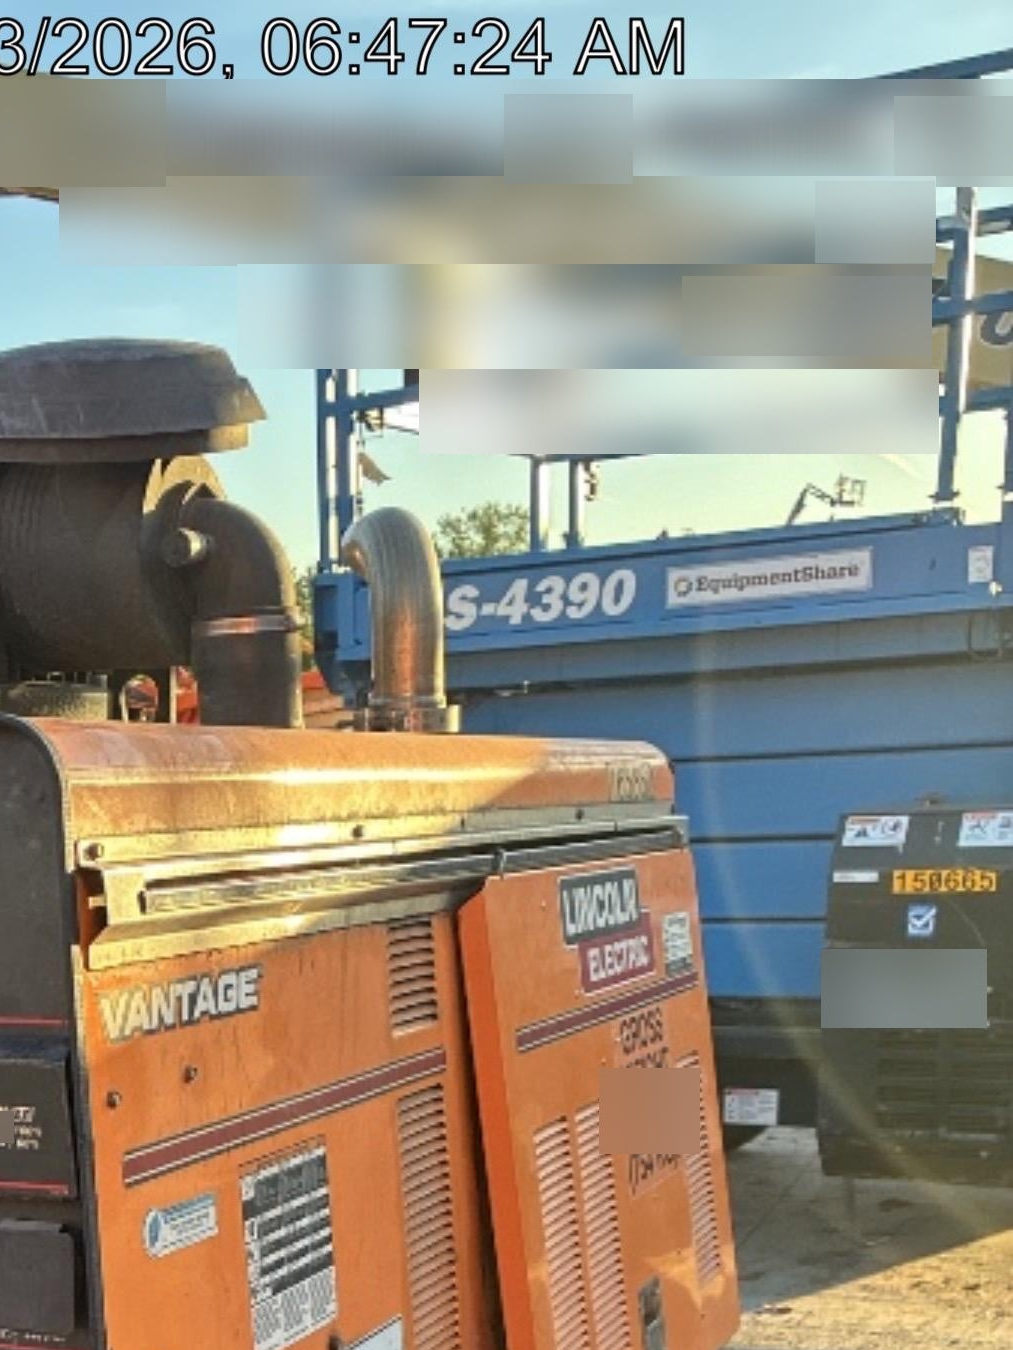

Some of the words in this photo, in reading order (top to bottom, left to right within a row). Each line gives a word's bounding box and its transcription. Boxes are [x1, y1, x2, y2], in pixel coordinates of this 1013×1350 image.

[695, 564, 860, 594] EquipmentShare
[893, 870, 994, 891] 150665
[563, 877, 638, 937] LINCOLN
[587, 935, 649, 983] ELECTRIC
[98, 966, 260, 1041] VANTAGE
